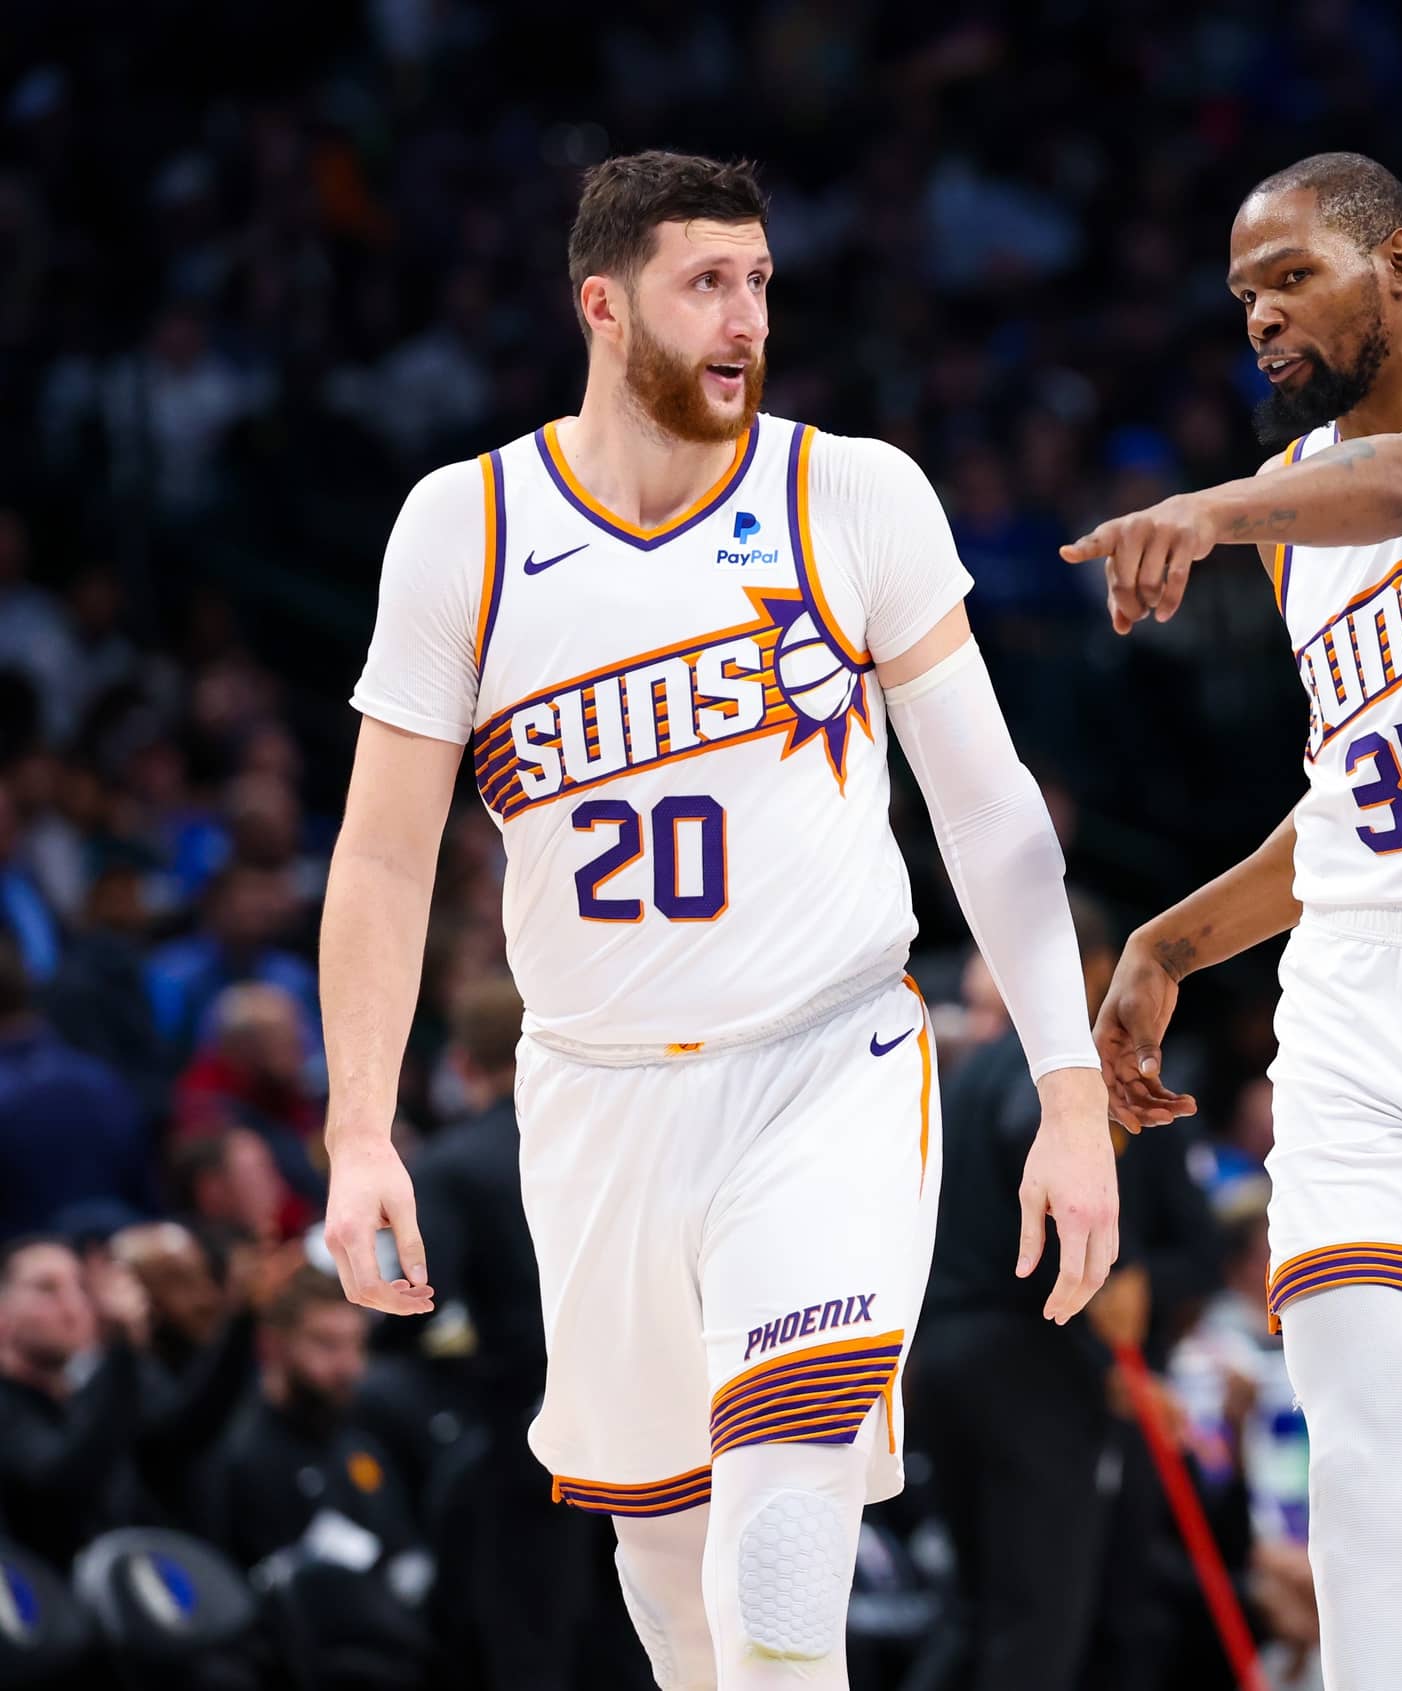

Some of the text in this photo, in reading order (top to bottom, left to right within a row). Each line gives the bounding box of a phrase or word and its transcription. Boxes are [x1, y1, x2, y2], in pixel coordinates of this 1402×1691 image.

[716, 549, 778, 567] PayPal
[510, 637, 765, 800] SUNS
[571, 795, 728, 923] 20
[744, 1292, 876, 1362] PHOENIX
